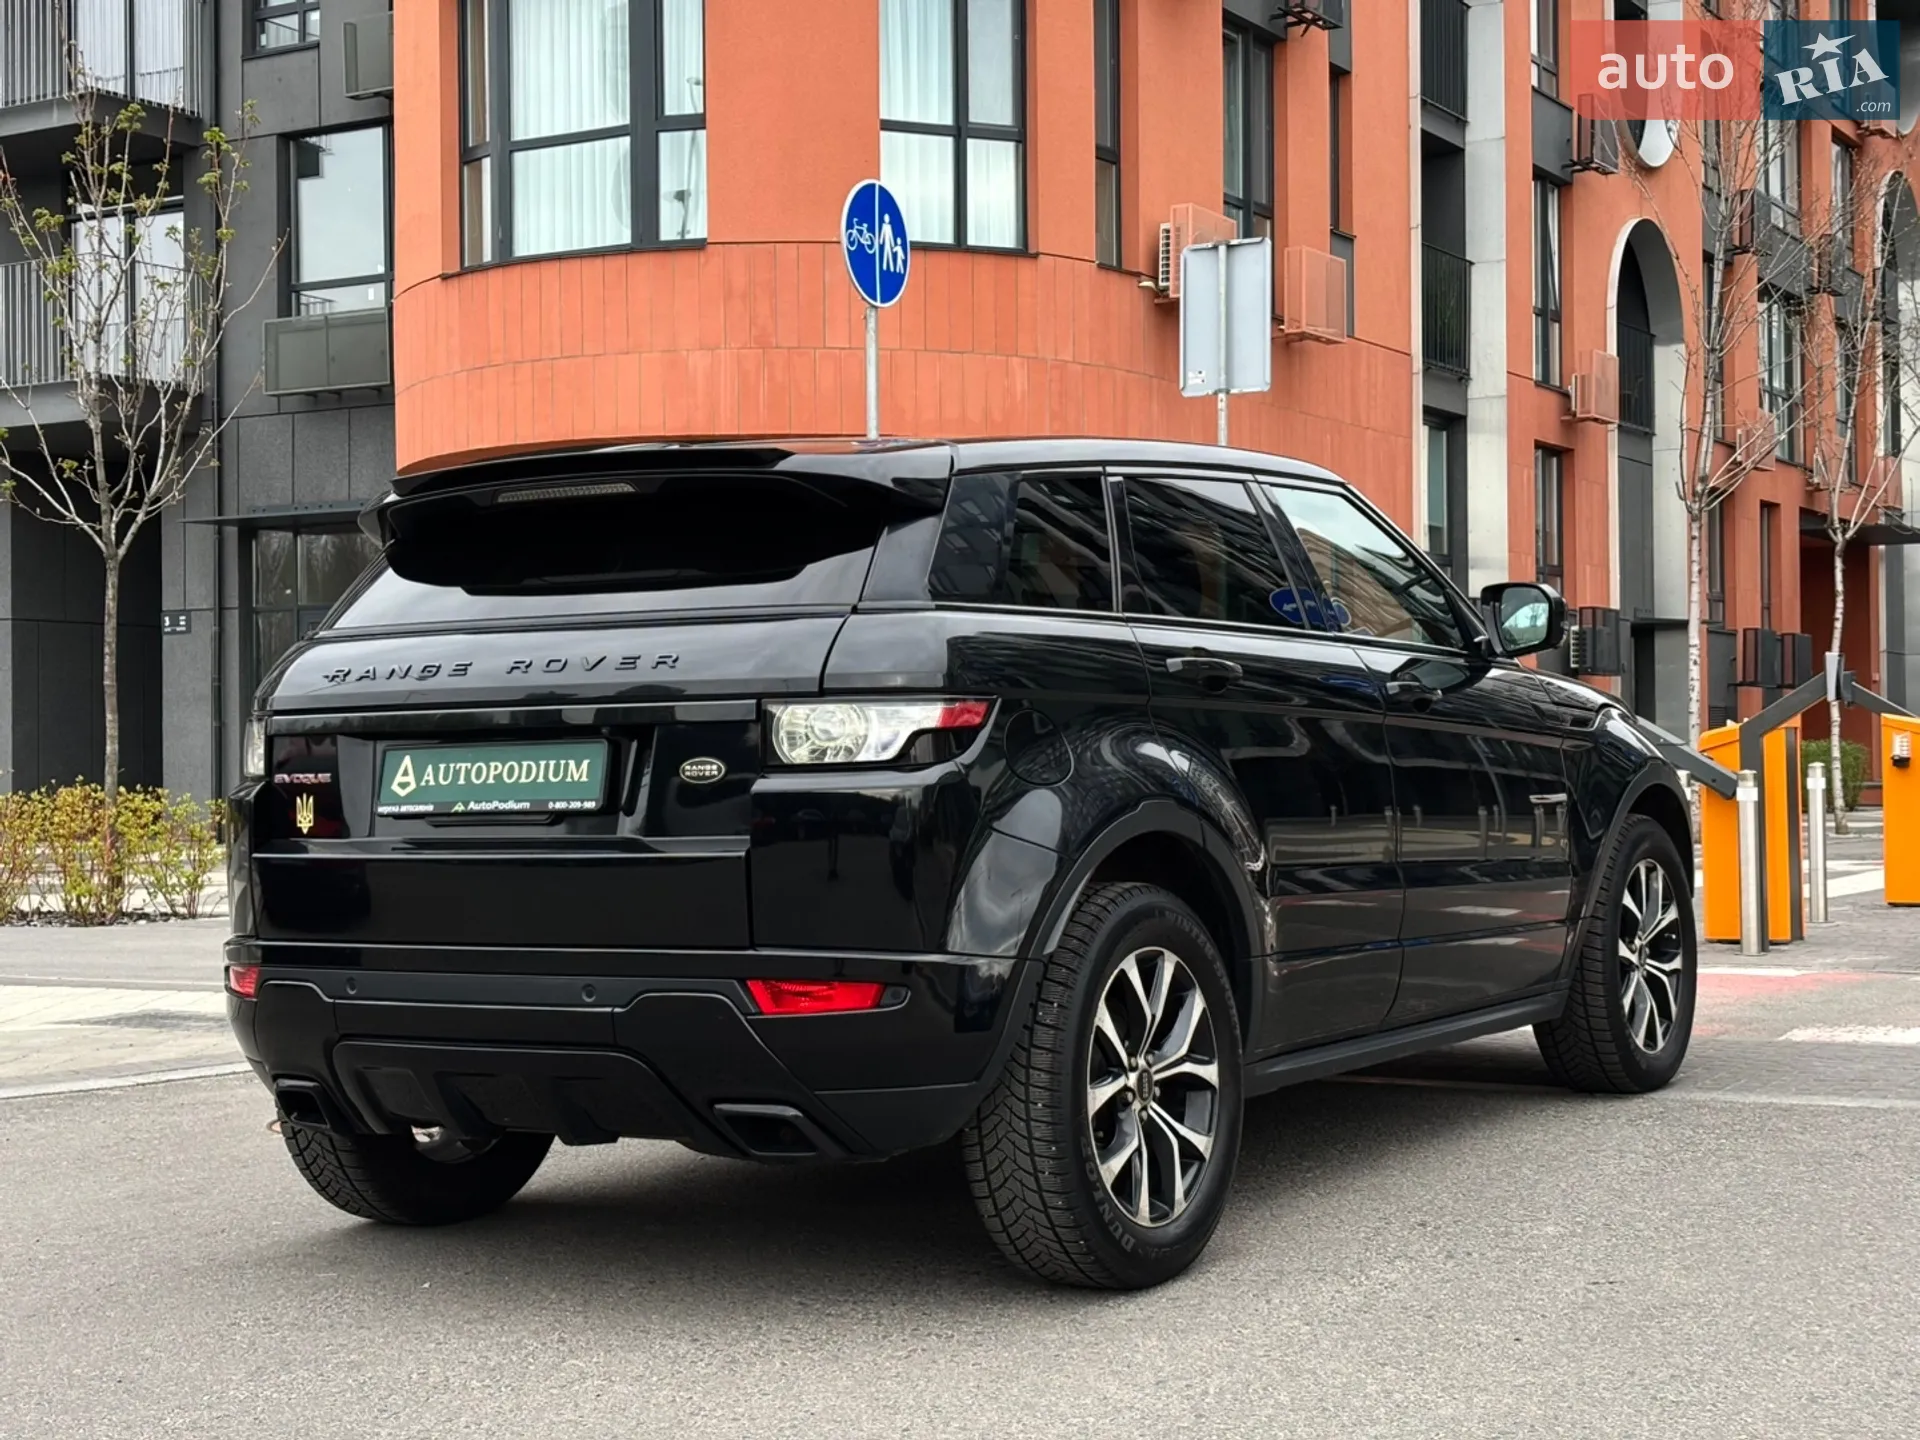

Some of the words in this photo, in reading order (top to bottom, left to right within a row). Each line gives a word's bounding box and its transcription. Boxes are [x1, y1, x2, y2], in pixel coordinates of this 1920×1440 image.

[322, 661, 473, 683] RANGE
[505, 653, 680, 675] ROVER
[274, 772, 332, 785] EVOQUE
[419, 759, 591, 787] AUTOPODIUM
[467, 800, 531, 812] AutoPodium
